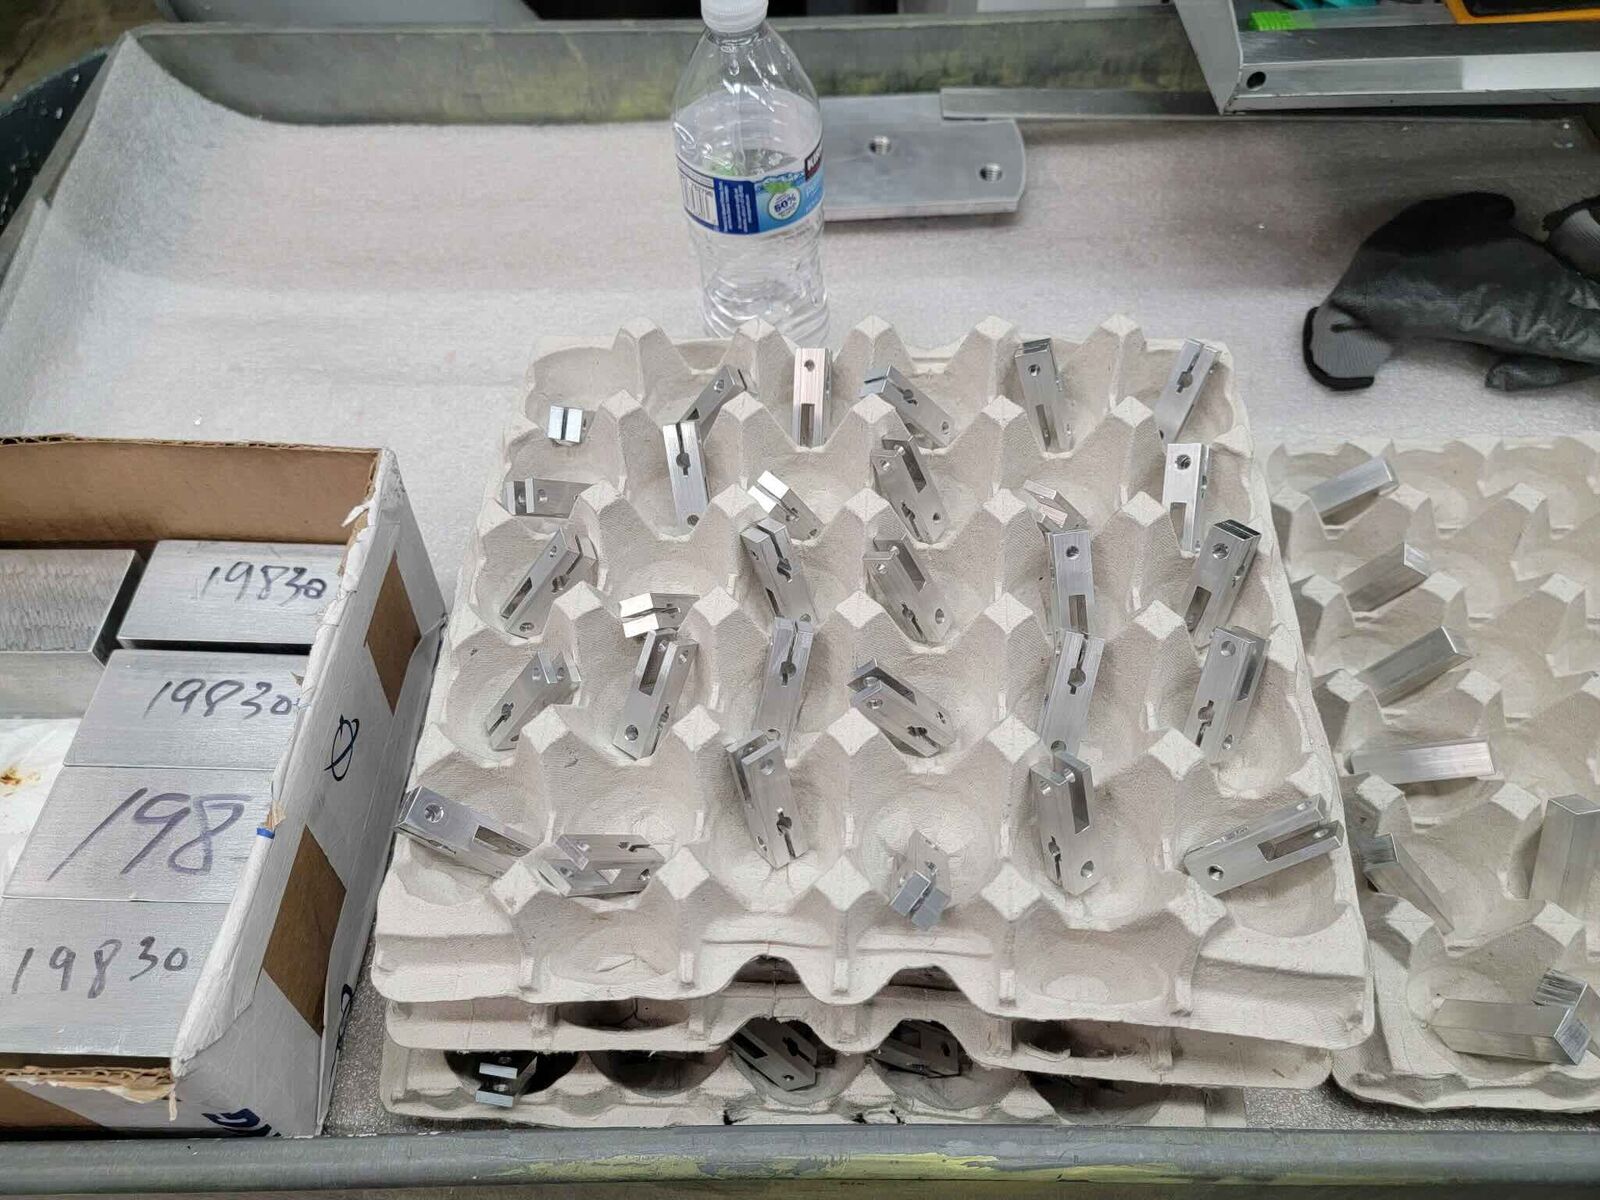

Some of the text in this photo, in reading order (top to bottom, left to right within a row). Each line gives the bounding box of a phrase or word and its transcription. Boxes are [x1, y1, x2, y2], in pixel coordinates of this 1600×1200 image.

[201, 561, 327, 606] 19830
[143, 678, 294, 720] 19830
[47, 787, 253, 881] 198
